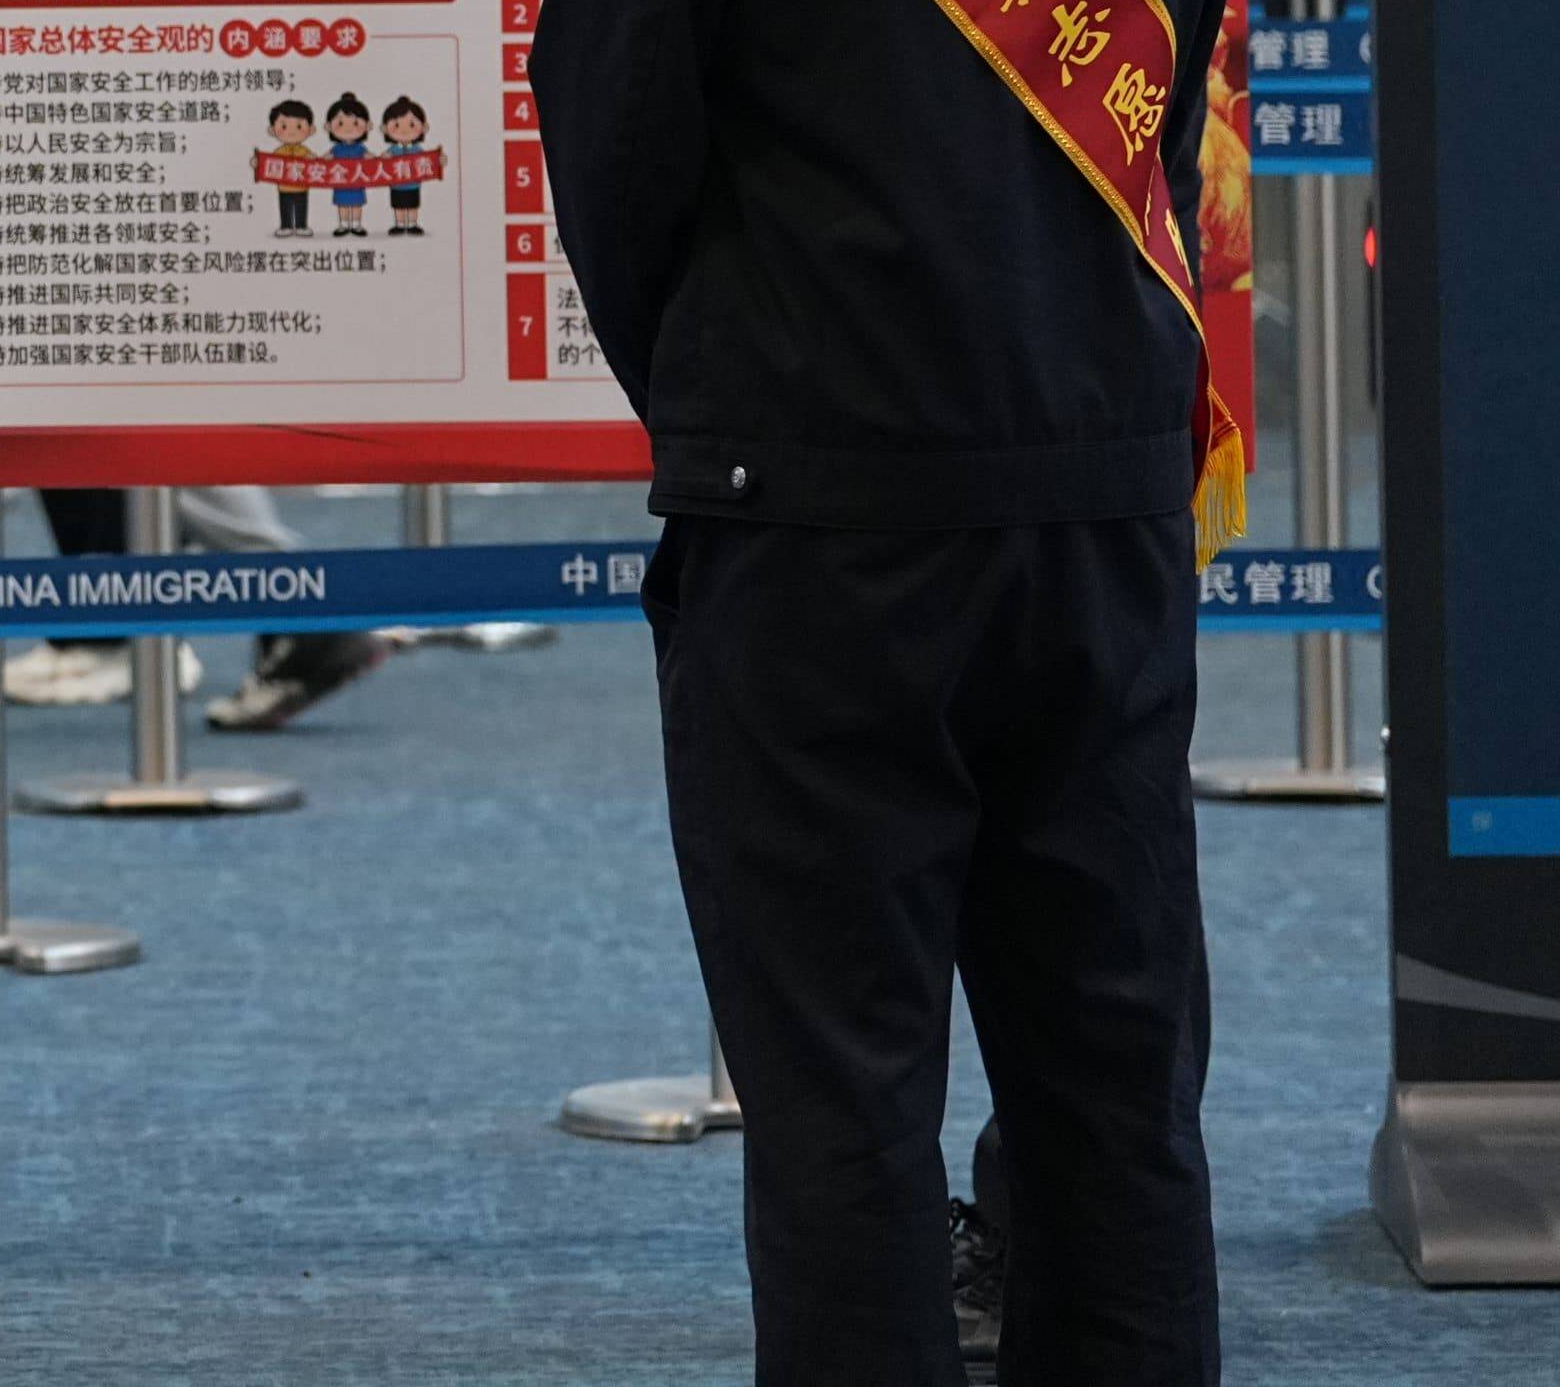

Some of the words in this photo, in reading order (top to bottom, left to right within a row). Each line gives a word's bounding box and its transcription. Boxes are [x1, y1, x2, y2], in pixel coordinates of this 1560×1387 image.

[514, 5, 527, 23] 2
[227, 26, 359, 51] 内涵要求
[515, 54, 527, 72] 3
[515, 102, 529, 120] 4
[1254, 102, 1343, 145] 管理
[263, 155, 434, 186] 国家安全人人有责
[517, 167, 530, 185] 5
[518, 233, 531, 254] 6
[558, 287, 579, 309] 法
[520, 316, 533, 337] 7
[561, 552, 645, 596] 中国
[1199, 560, 1334, 604] 民管理
[68, 567, 326, 606] IMMIGRATION
